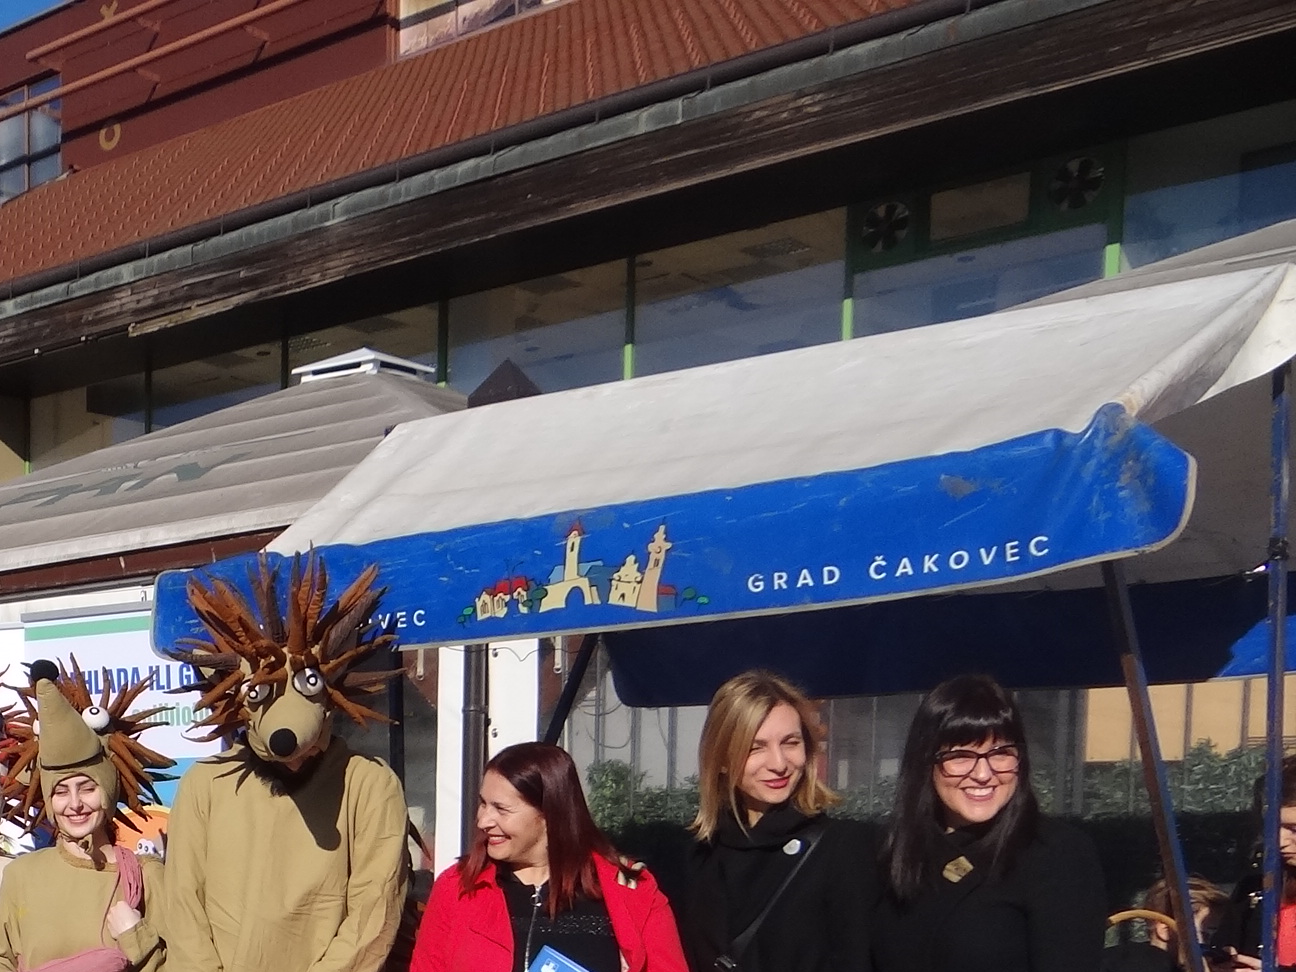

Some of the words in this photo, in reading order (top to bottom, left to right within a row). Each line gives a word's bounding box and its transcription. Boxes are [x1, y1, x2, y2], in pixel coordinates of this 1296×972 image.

[747, 564, 842, 593] GRAD
[868, 534, 1050, 580] ČAKOVEC
[148, 664, 171, 691] ILI
[178, 663, 197, 687] G
